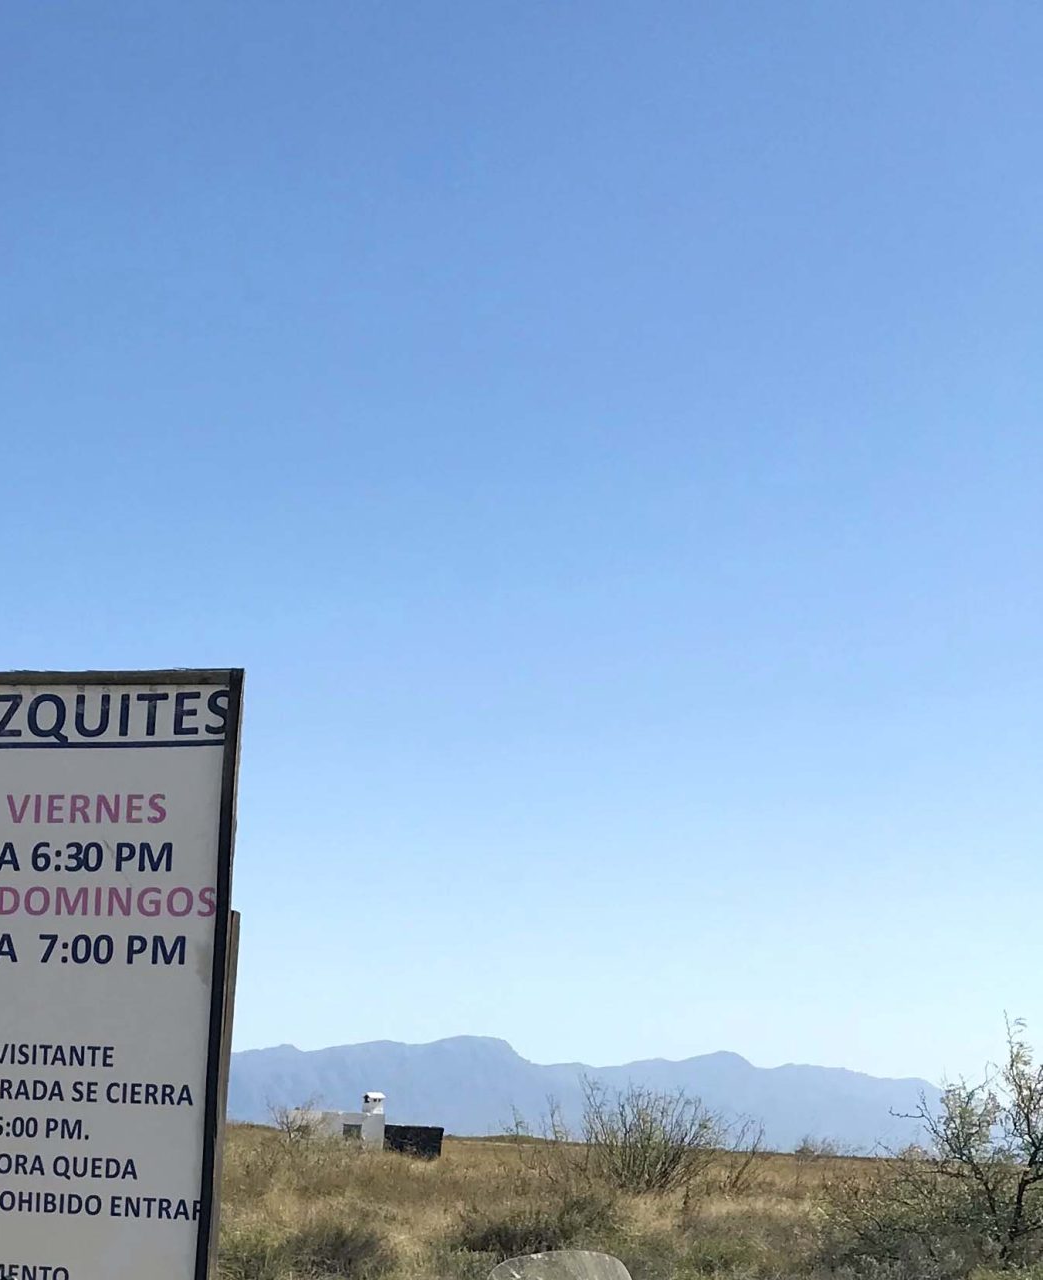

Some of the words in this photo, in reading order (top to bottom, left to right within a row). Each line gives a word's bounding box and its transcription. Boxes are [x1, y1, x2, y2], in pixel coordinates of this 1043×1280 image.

[6, 793, 167, 824] VIERNES
[31, 841, 104, 873] 6:30
[114, 841, 174, 873] PM
[38, 933, 114, 965] 7:00
[126, 934, 187, 966] PM
[71, 1080, 99, 1103] SE
[105, 1081, 194, 1107] CIERRA
[45, 1117, 90, 1141] PM.
[52, 1155, 138, 1181] QUEDA
